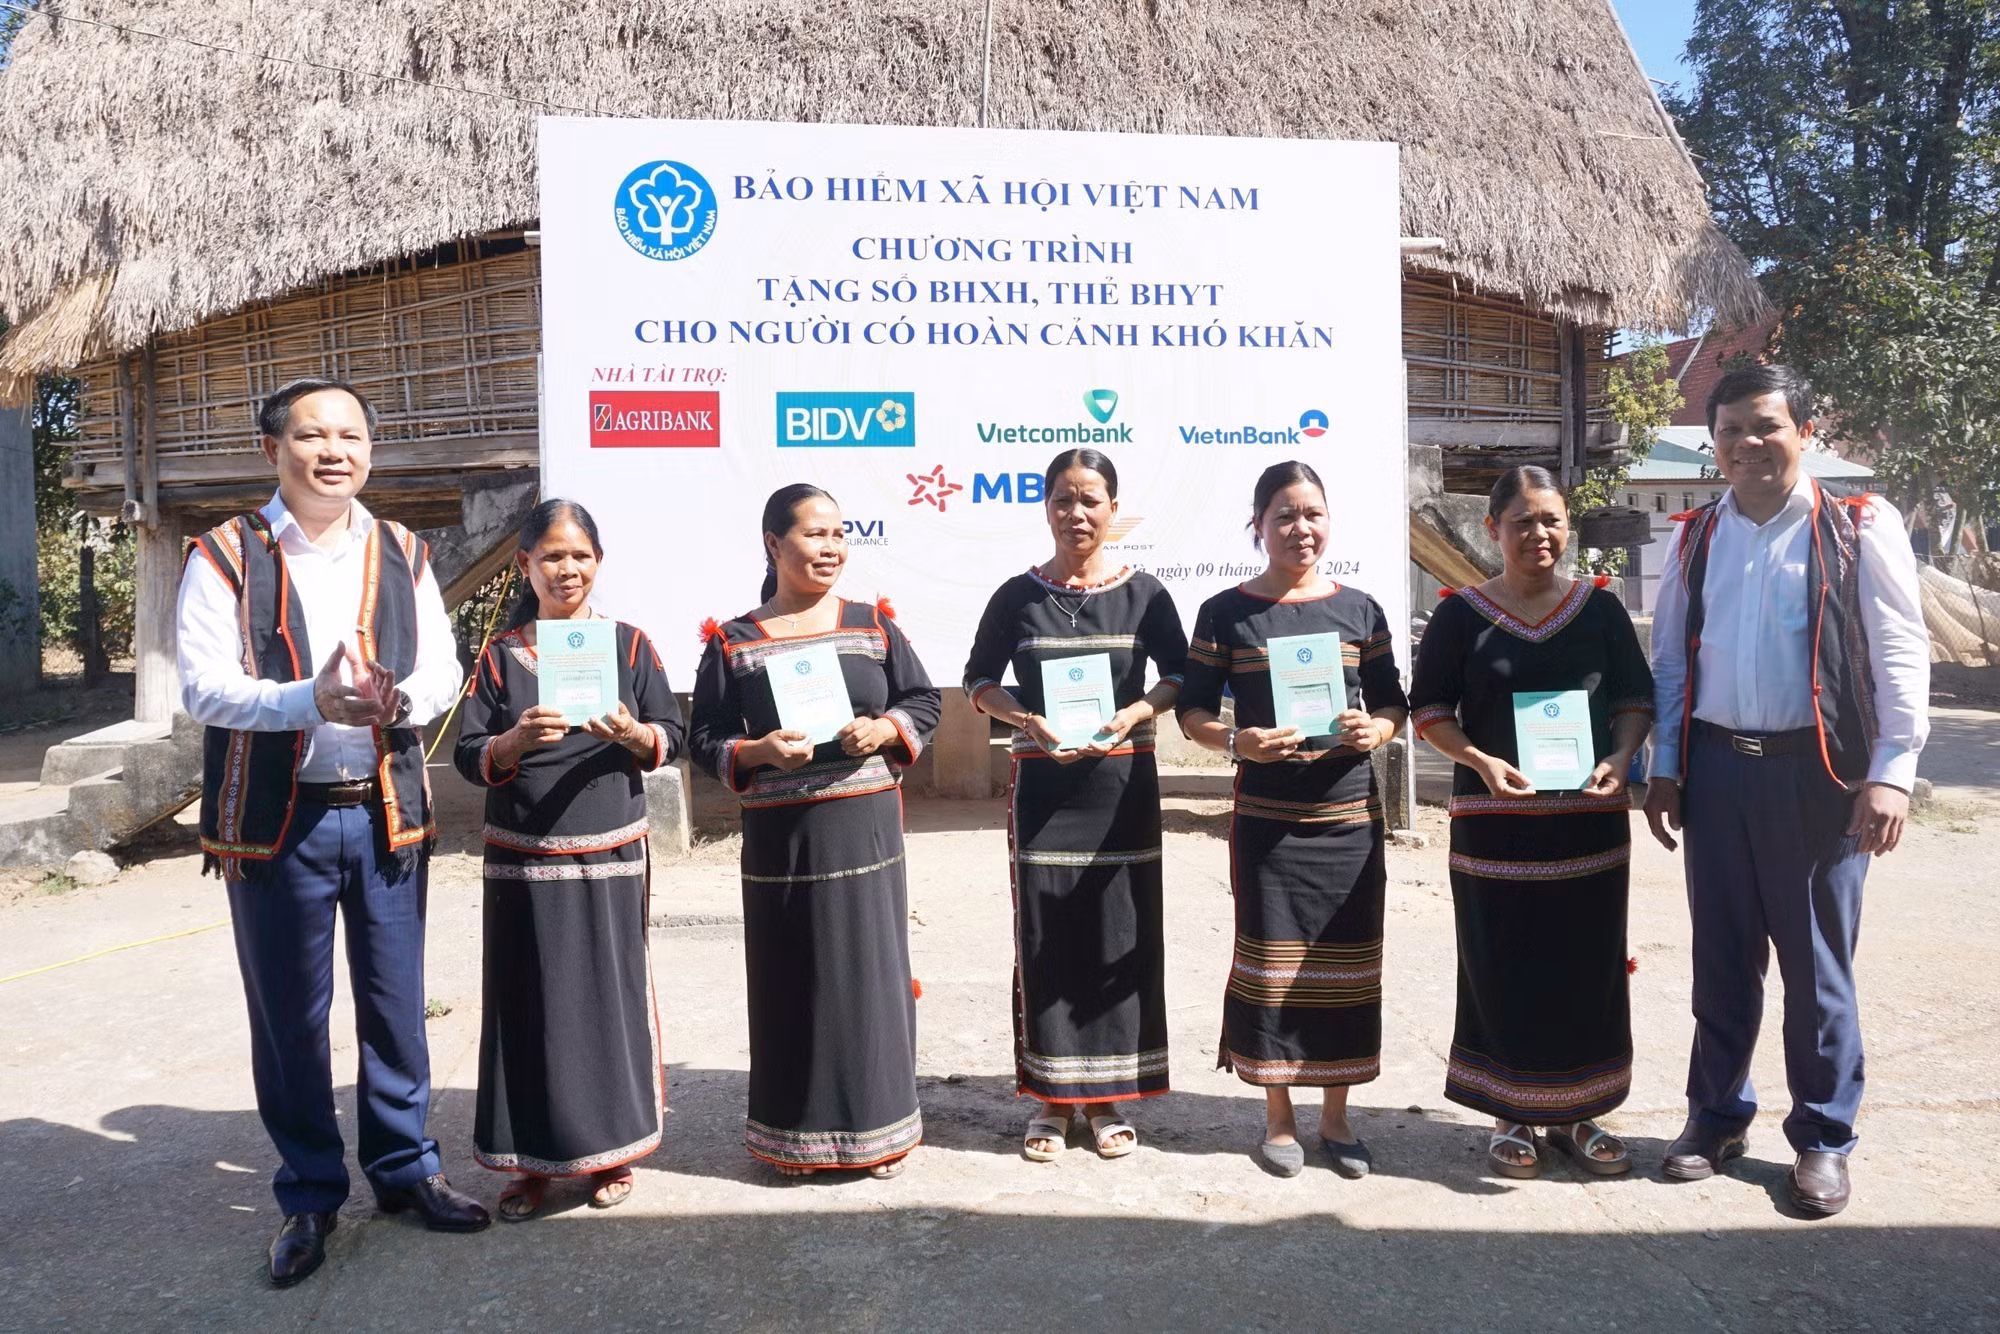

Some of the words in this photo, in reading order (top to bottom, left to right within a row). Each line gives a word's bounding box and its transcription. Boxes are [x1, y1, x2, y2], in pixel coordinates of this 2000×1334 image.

[734, 168, 813, 200] BẢO
[827, 170, 926, 202] HIỂM
[940, 175, 990, 204] XÃ
[1004, 178, 1070, 212] HỘI
[1082, 180, 1168, 214] VIỆT
[1179, 185, 1259, 210] NAM
[702, 210, 716, 235] NAM
[852, 234, 1011, 261] CHƯƠNG
[1022, 234, 1133, 264] TRÌNH
[757, 275, 859, 308] TẶNG
[872, 273, 917, 303] SỔ
[930, 280, 1039, 308] BHXH,
[1048, 277, 1118, 304] THẺ
[1131, 284, 1224, 306] BHYT
[635, 319, 717, 343] CHO
[729, 315, 850, 345] NGƯỜI
[863, 315, 915, 345] CÓ
[927, 316, 1028, 345] HOÀN
[1040, 317, 1138, 346] CẢNH
[1152, 319, 1227, 347] KHÓ
[1239, 320, 1333, 348] KHĂN
[592, 363, 634, 383] NHÀ
[642, 363, 675, 383] TÀI
[682, 367, 728, 387] TRỢ:
[615, 410, 714, 432] AGRIBANK
[786, 407, 875, 441] BIDV
[977, 422, 1134, 443] Vietcombank
[1179, 425, 1301, 445] VietinBank
[972, 473, 1046, 503] MB
[842, 520, 883, 537] PVI
[845, 538, 888, 546] SURANCE
[1156, 563, 1191, 581] ngày
[1196, 562, 1214, 577] 09
[1219, 562, 1262, 578] tháng
[1325, 561, 1360, 575] 2024
